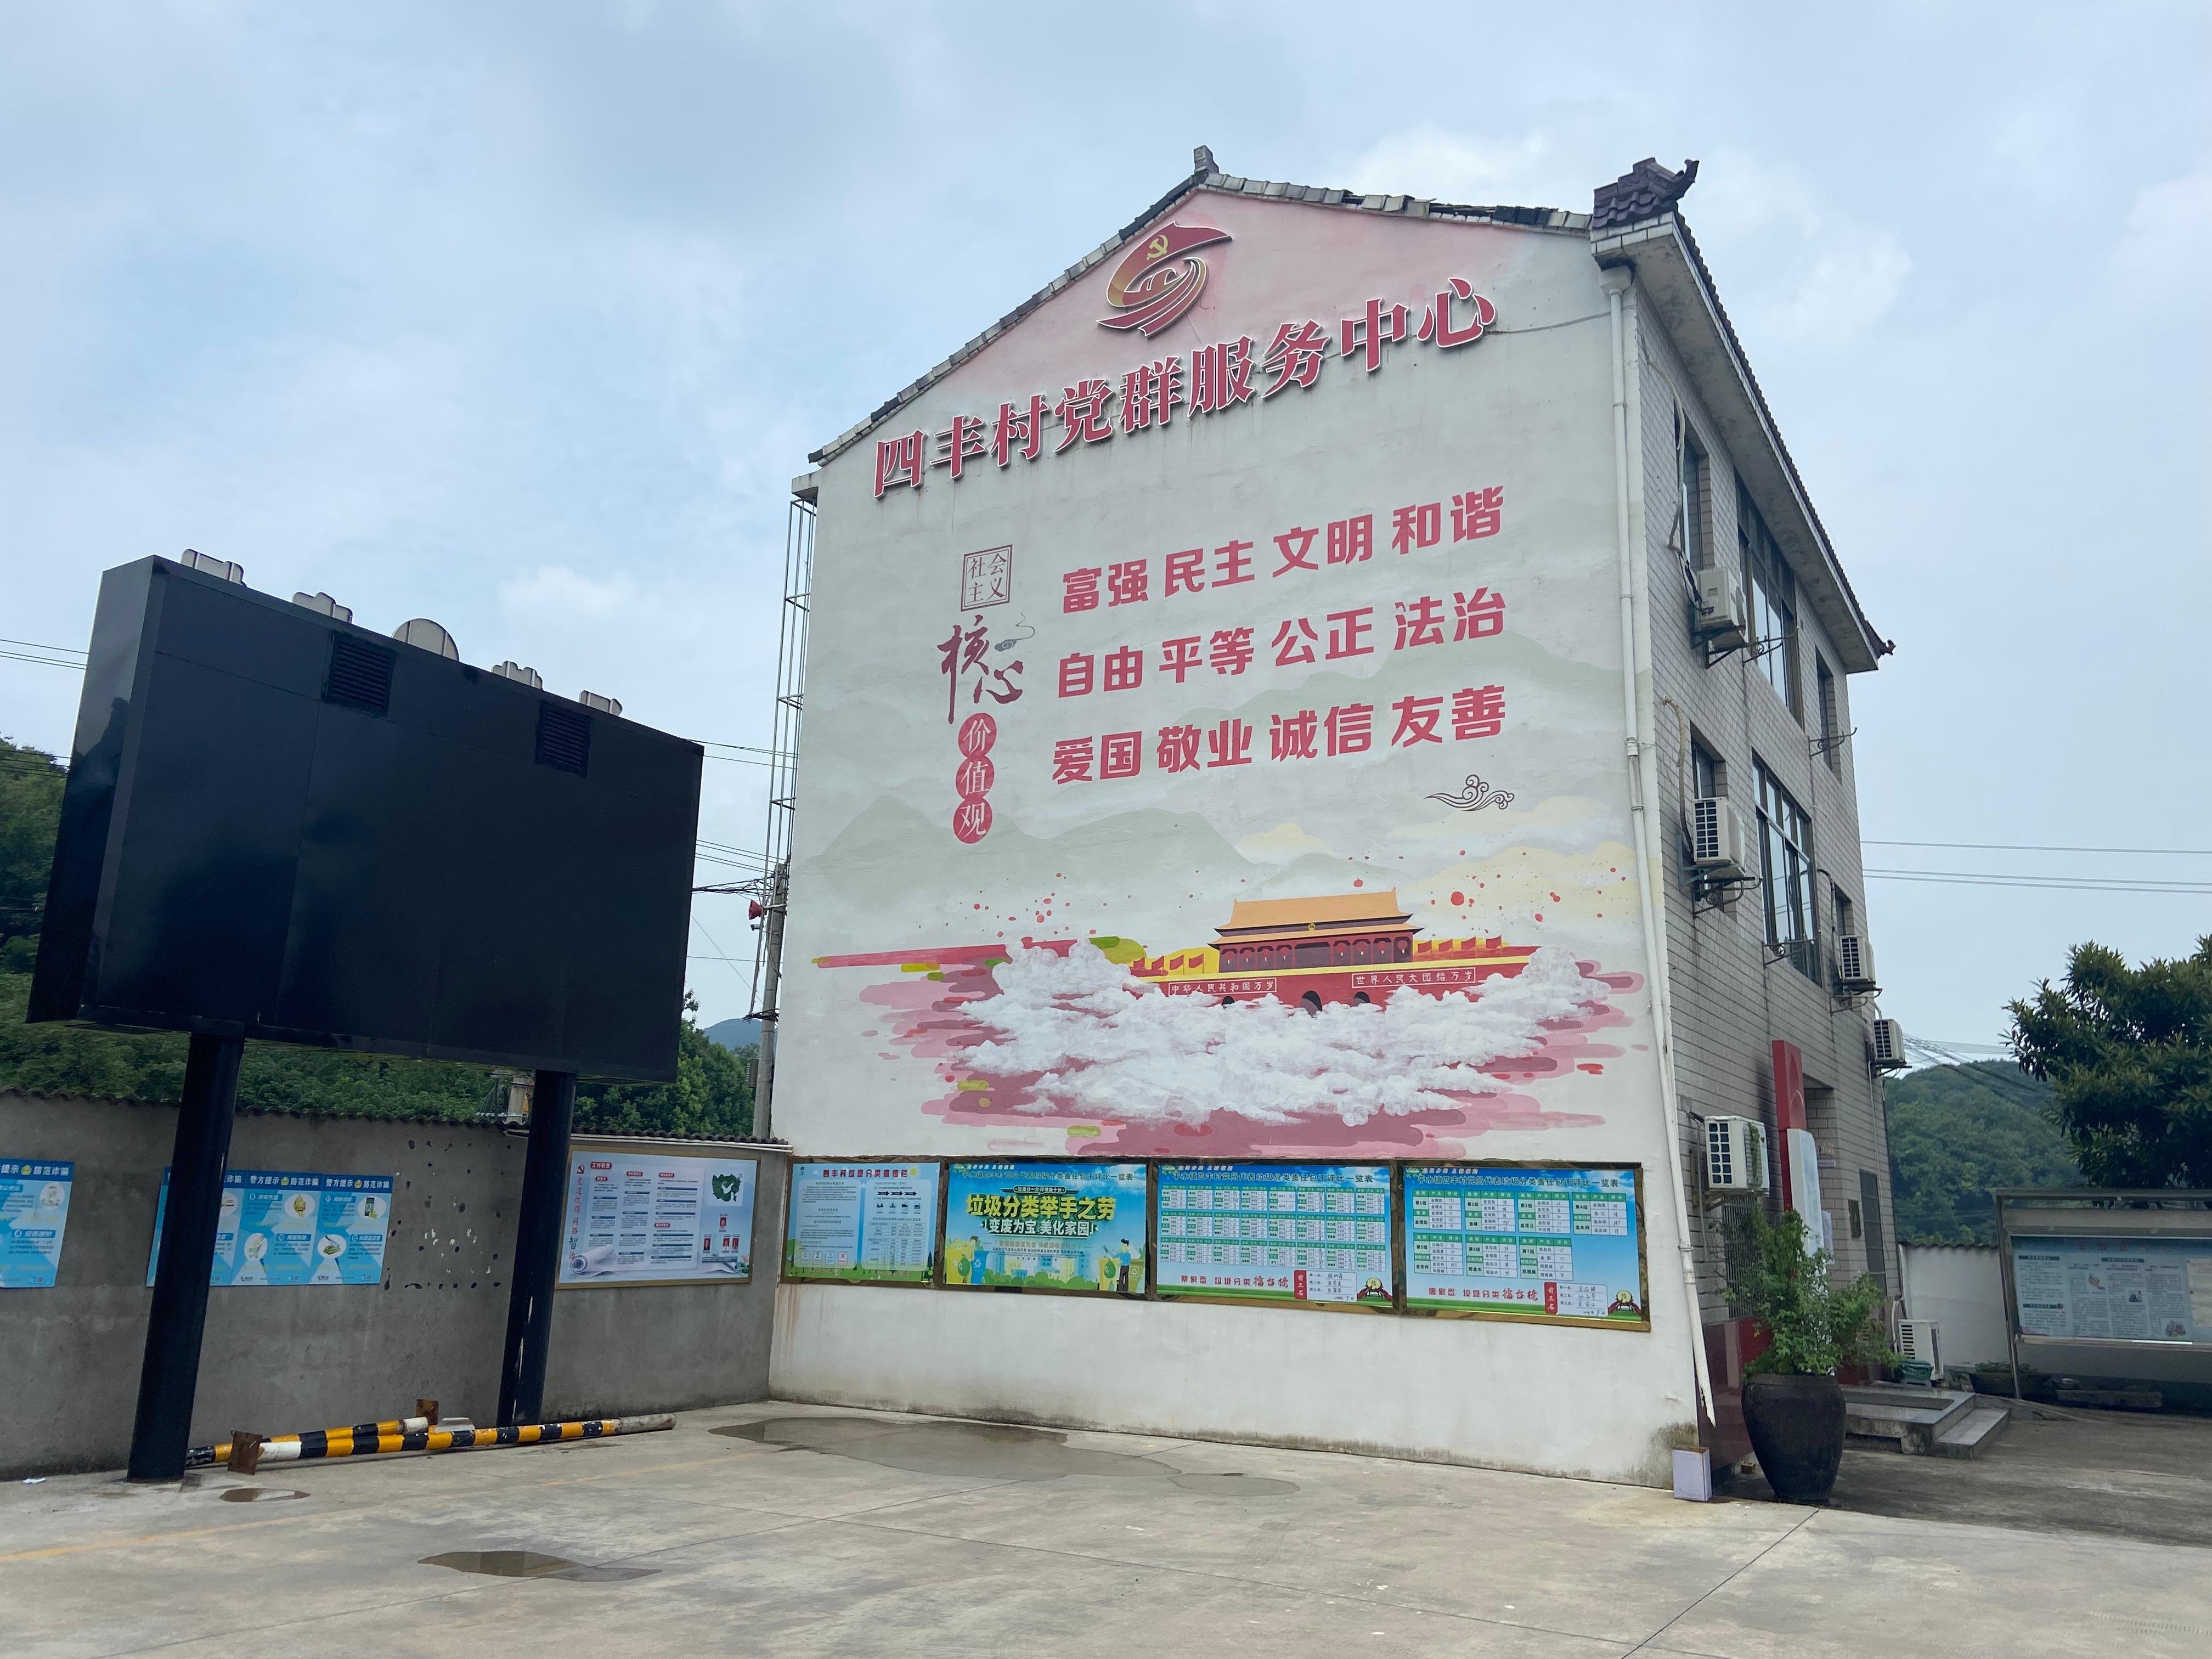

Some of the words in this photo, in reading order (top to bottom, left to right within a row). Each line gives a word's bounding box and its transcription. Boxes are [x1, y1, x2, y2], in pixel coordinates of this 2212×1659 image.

[873, 276, 1497, 498] 四丰村党群服务中心
[1063, 559, 1149, 613] 富强
[1164, 539, 1255, 597] 民主
[1273, 514, 1373, 579] 文明
[1392, 486, 1504, 555] 和谐
[1058, 645, 1144, 699] 自由
[1159, 627, 1255, 684] 平等
[1272, 607, 1375, 668] 公正
[1394, 586, 1506, 651] 法治
[936, 614, 1024, 725] 核心
[1052, 731, 1142, 785] 爱国
[1158, 719, 1253, 773] 敬业
[1269, 703, 1374, 762] 诚信
[1391, 685, 1505, 747] 友善
[957, 718, 992, 838] 价值观
[1356, 970, 1474, 986] 世界人民大团结万岁
[1171, 980, 1274, 994] 中华人民共和国万岁
[0, 1164, 19, 1173] 提示
[33, 1166, 69, 1176] 防范诈骗
[1172, 1172, 1373, 1183] 平水镇四丰村党员代表垃圾分类责任包干评比一览表
[250, 1175, 279, 1184] 警方提示
[290, 1177, 319, 1186] 防范诈骗
[326, 1178, 353, 1187] 警方提示
[363, 1180, 390, 1189] 防范诈骗
[1418, 1175, 1619, 1188] 平水镇四丰村党员代表垃圾分类责任包干评比一览表
[966, 1194, 1116, 1221] 垃圾分类举手之劳
[989, 1218, 1036, 1234] 变废为宝
[1040, 1220, 1090, 1235] 美化家园
